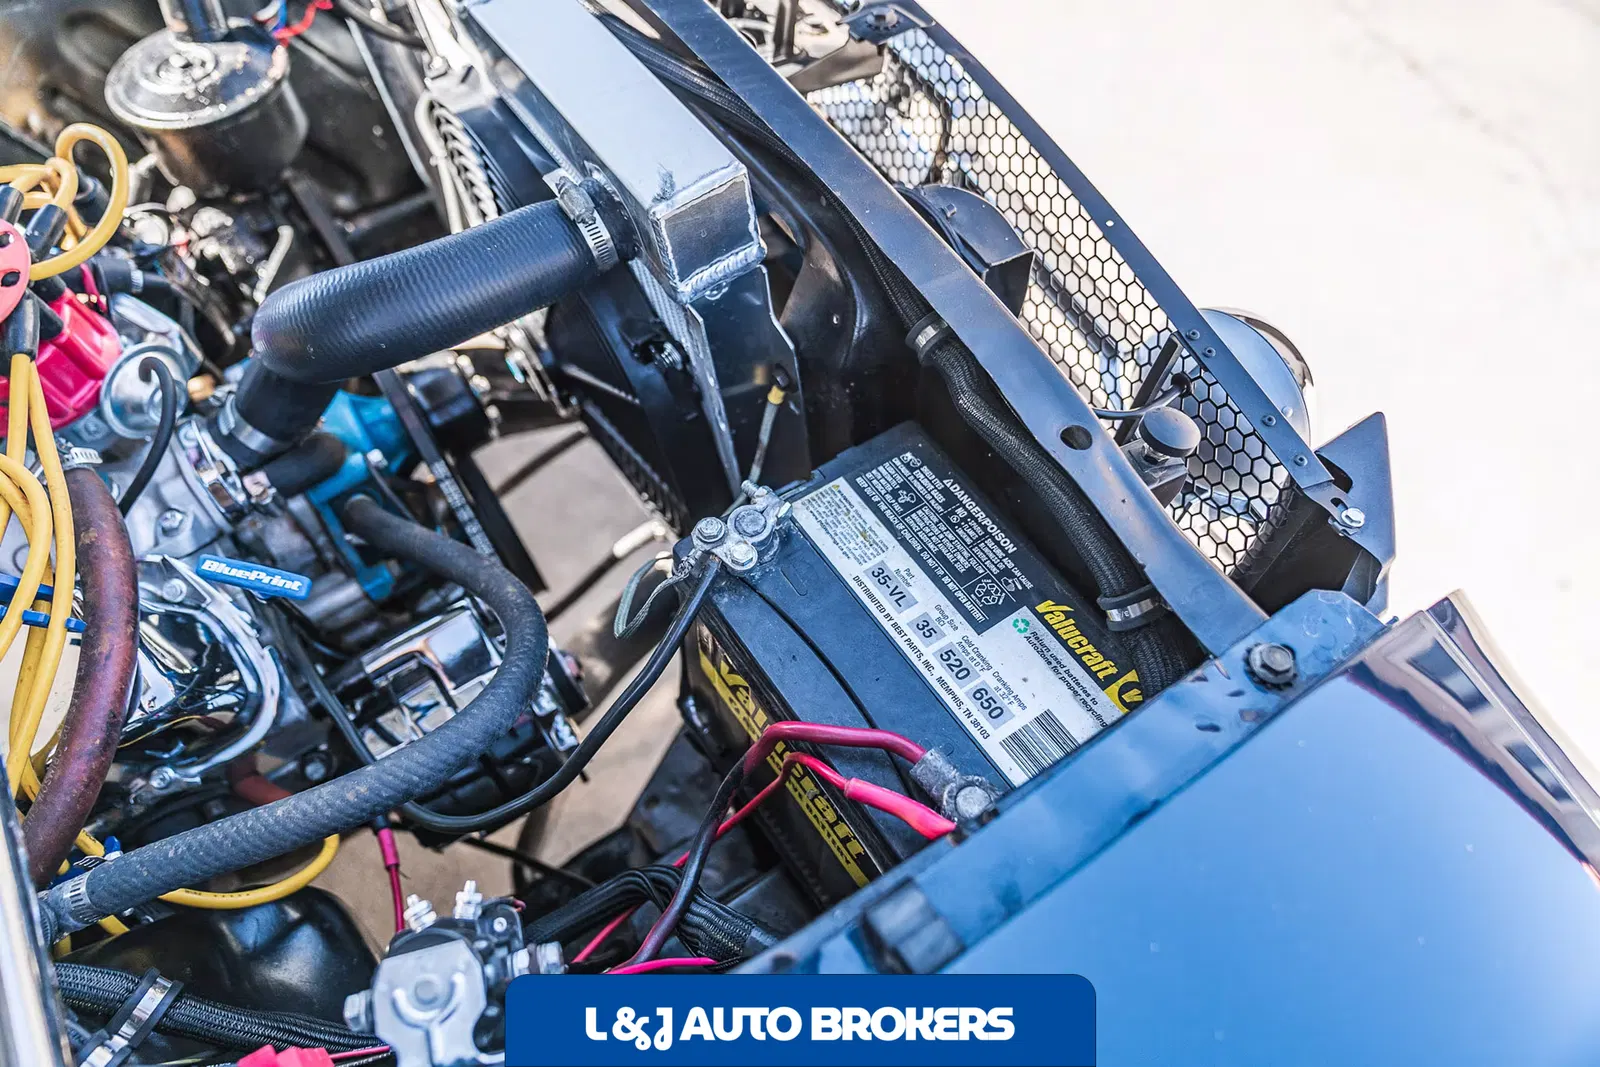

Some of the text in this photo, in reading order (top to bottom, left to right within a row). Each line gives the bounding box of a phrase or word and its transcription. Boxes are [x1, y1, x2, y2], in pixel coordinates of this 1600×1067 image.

[950, 484, 1016, 553] DANGER/POISON
[954, 506, 967, 518] NO
[201, 559, 303, 591] BluePrint
[871, 567, 906, 607] 35-VL
[893, 568, 912, 587] Number
[903, 567, 915, 580] Part
[915, 619, 937, 638] 35
[934, 604, 958, 631] Group Size
[934, 616, 946, 627] BCI
[955, 641, 971, 657] Amps
[968, 655, 977, 663] at
[961, 634, 993, 671] Cold Cranking
[1034, 598, 1119, 679] Valucraft
[852, 575, 886, 613] DISTRIBUTED
[882, 612, 894, 622] BY
[890, 621, 907, 638] BEST
[903, 637, 924, 661] PARTS,
[935, 676, 964, 709] MEMPHIS,
[962, 707, 973, 719] TN
[970, 717, 990, 739] 38103
[939, 649, 970, 680] 520
[1029, 631, 1098, 706] Return used batteries to
[992, 670, 1027, 710] Cranking Amps
[993, 685, 1002, 693] at
[1023, 635, 1110, 730] AutoZone for proper recycling
[972, 687, 1004, 719] 650
